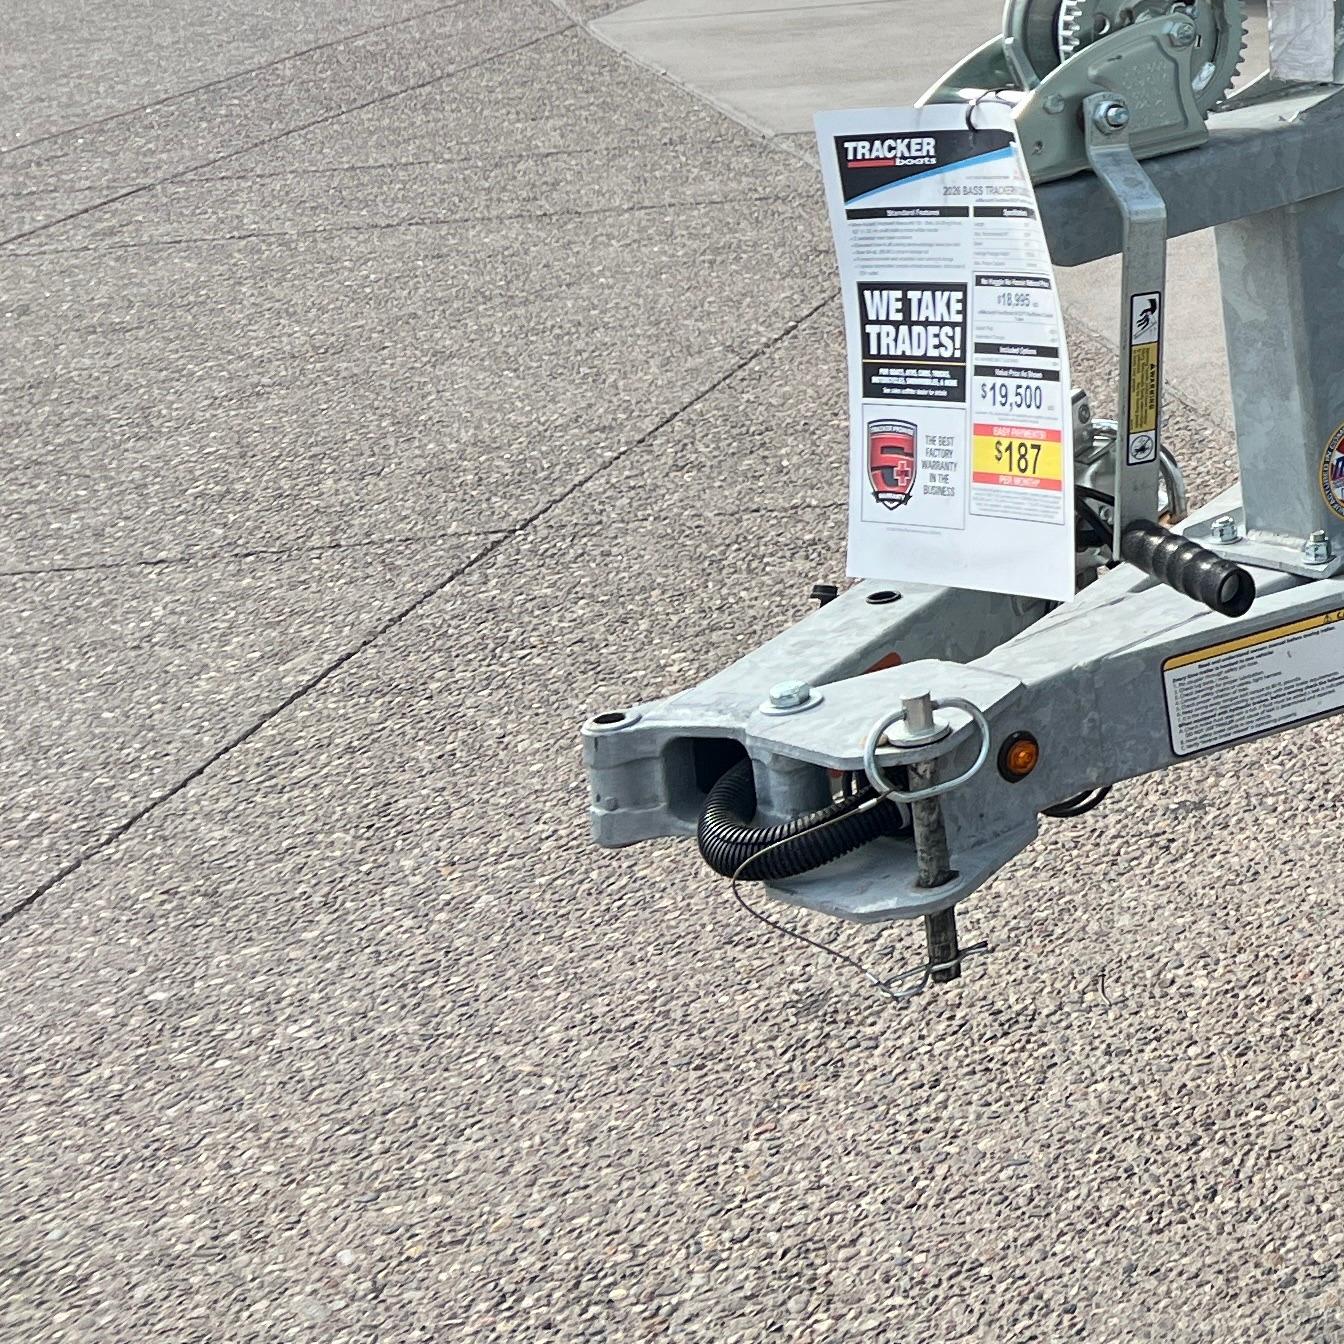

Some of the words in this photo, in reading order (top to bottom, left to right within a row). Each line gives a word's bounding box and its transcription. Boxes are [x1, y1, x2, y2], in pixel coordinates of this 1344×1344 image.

[844, 137, 935, 160] TRACKER
[896, 156, 937, 166] boats
[963, 185, 984, 196] BASS
[863, 290, 903, 321] WE
[907, 291, 963, 322] TAKE
[865, 324, 962, 358] TRADES!
[981, 382, 1042, 412] $19,500
[925, 435, 937, 446] THE
[938, 436, 955, 447] BEST
[925, 448, 954, 459] FACTORY
[994, 440, 1042, 475] $187
[921, 460, 958, 472] WARRANTY
[929, 472, 937, 483] IN
[938, 473, 949, 484] THE
[923, 484, 955, 497] BUSINESS
